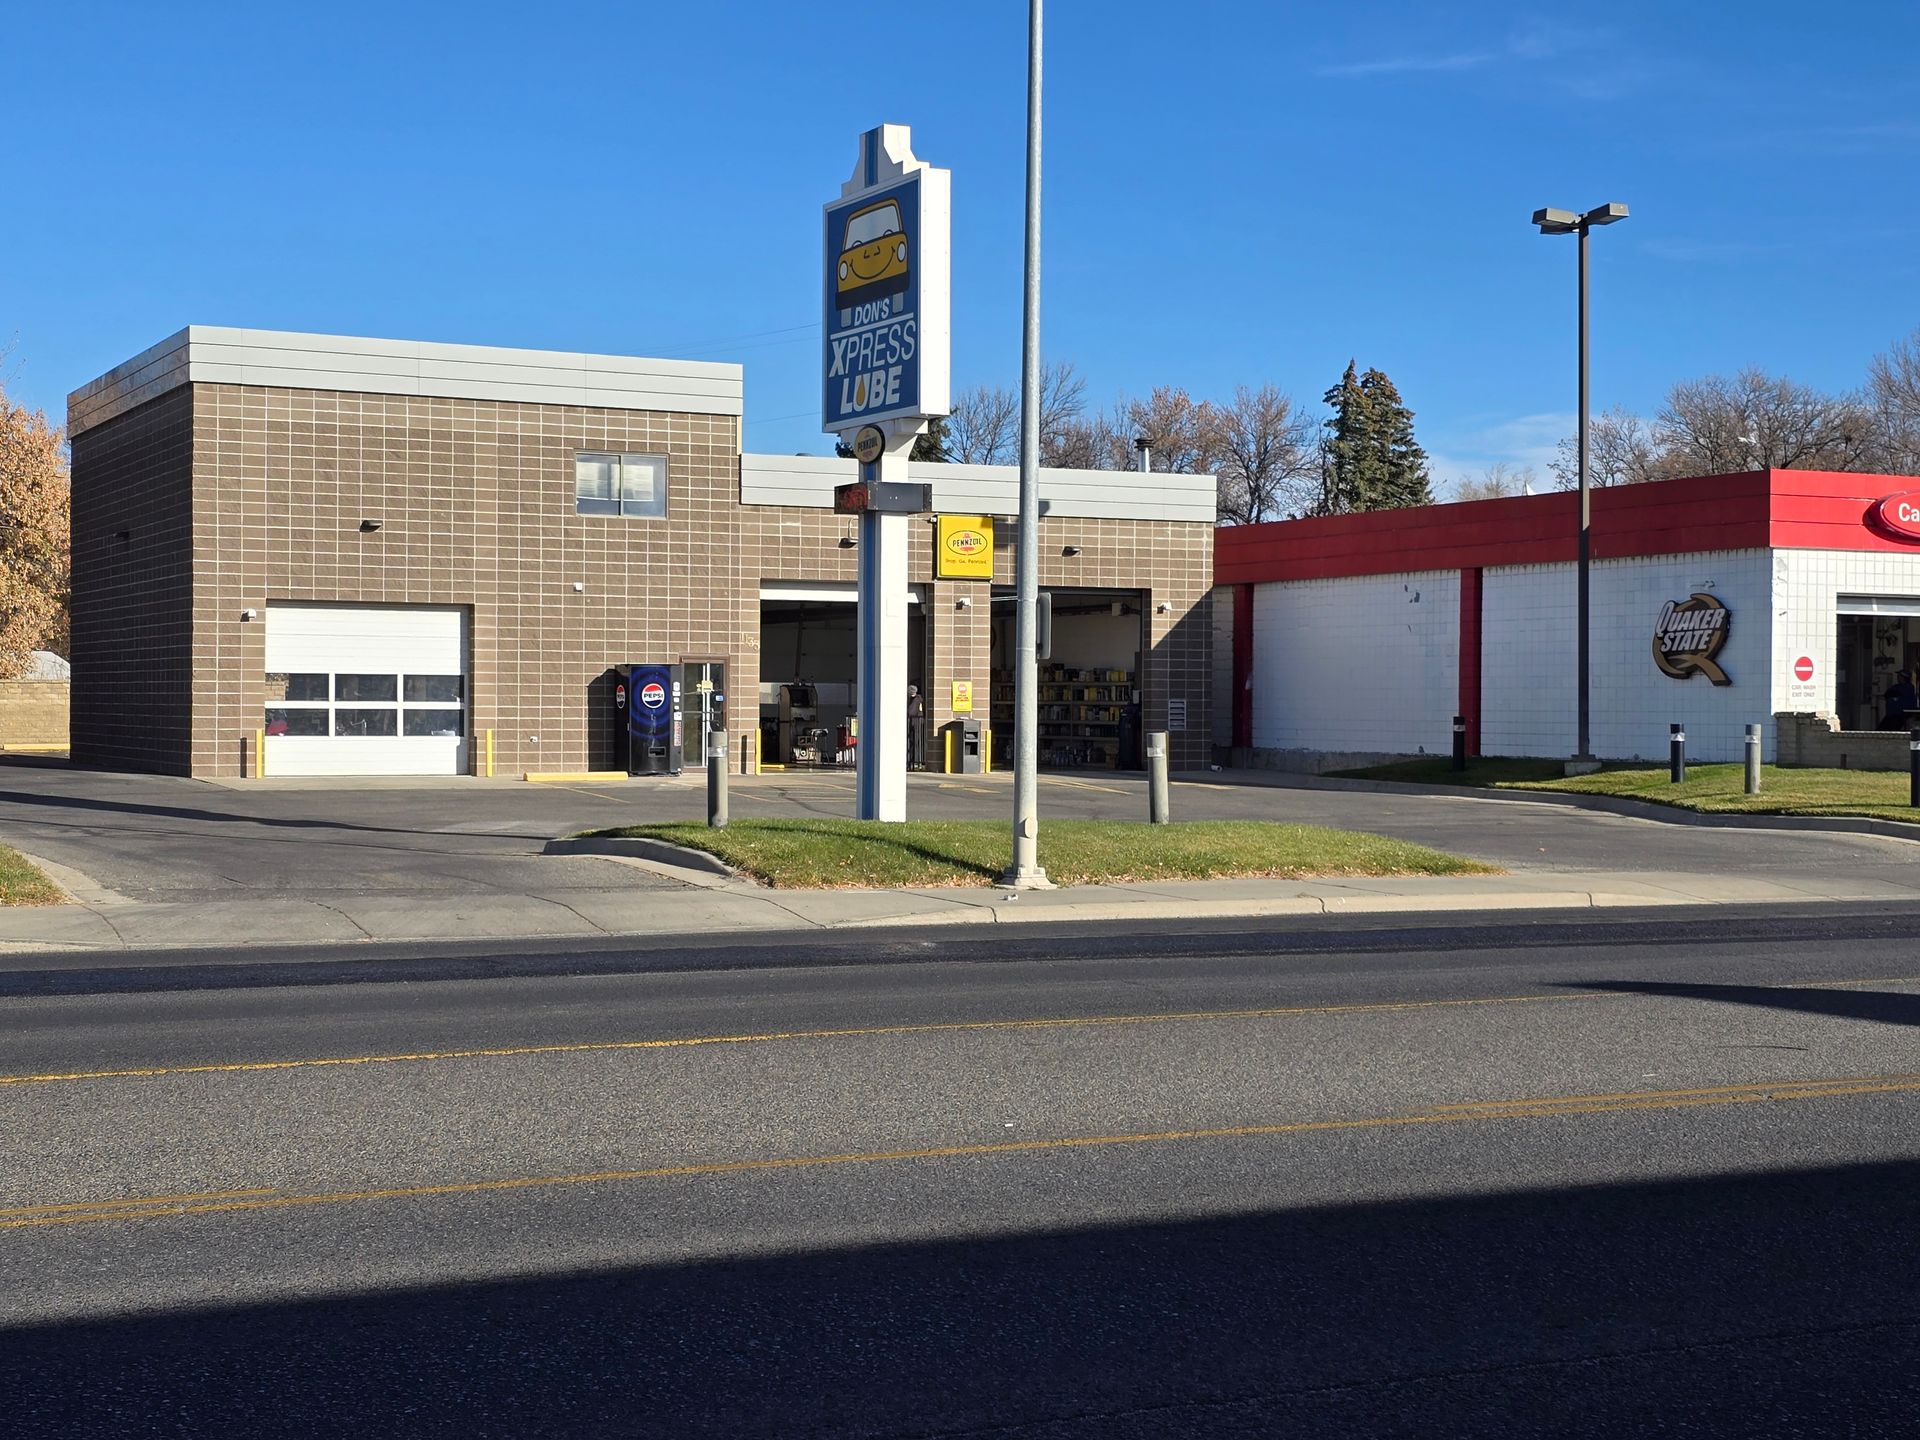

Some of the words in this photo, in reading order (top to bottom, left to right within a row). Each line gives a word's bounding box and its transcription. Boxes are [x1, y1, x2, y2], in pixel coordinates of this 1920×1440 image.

[854, 298, 890, 326] DON'S
[829, 320, 916, 378] XPRESS
[840, 365, 902, 415] LUBE
[952, 538, 982, 547] PENNZOIL
[1656, 601, 1726, 637] QUAKER
[1660, 629, 1713, 652] STATE
